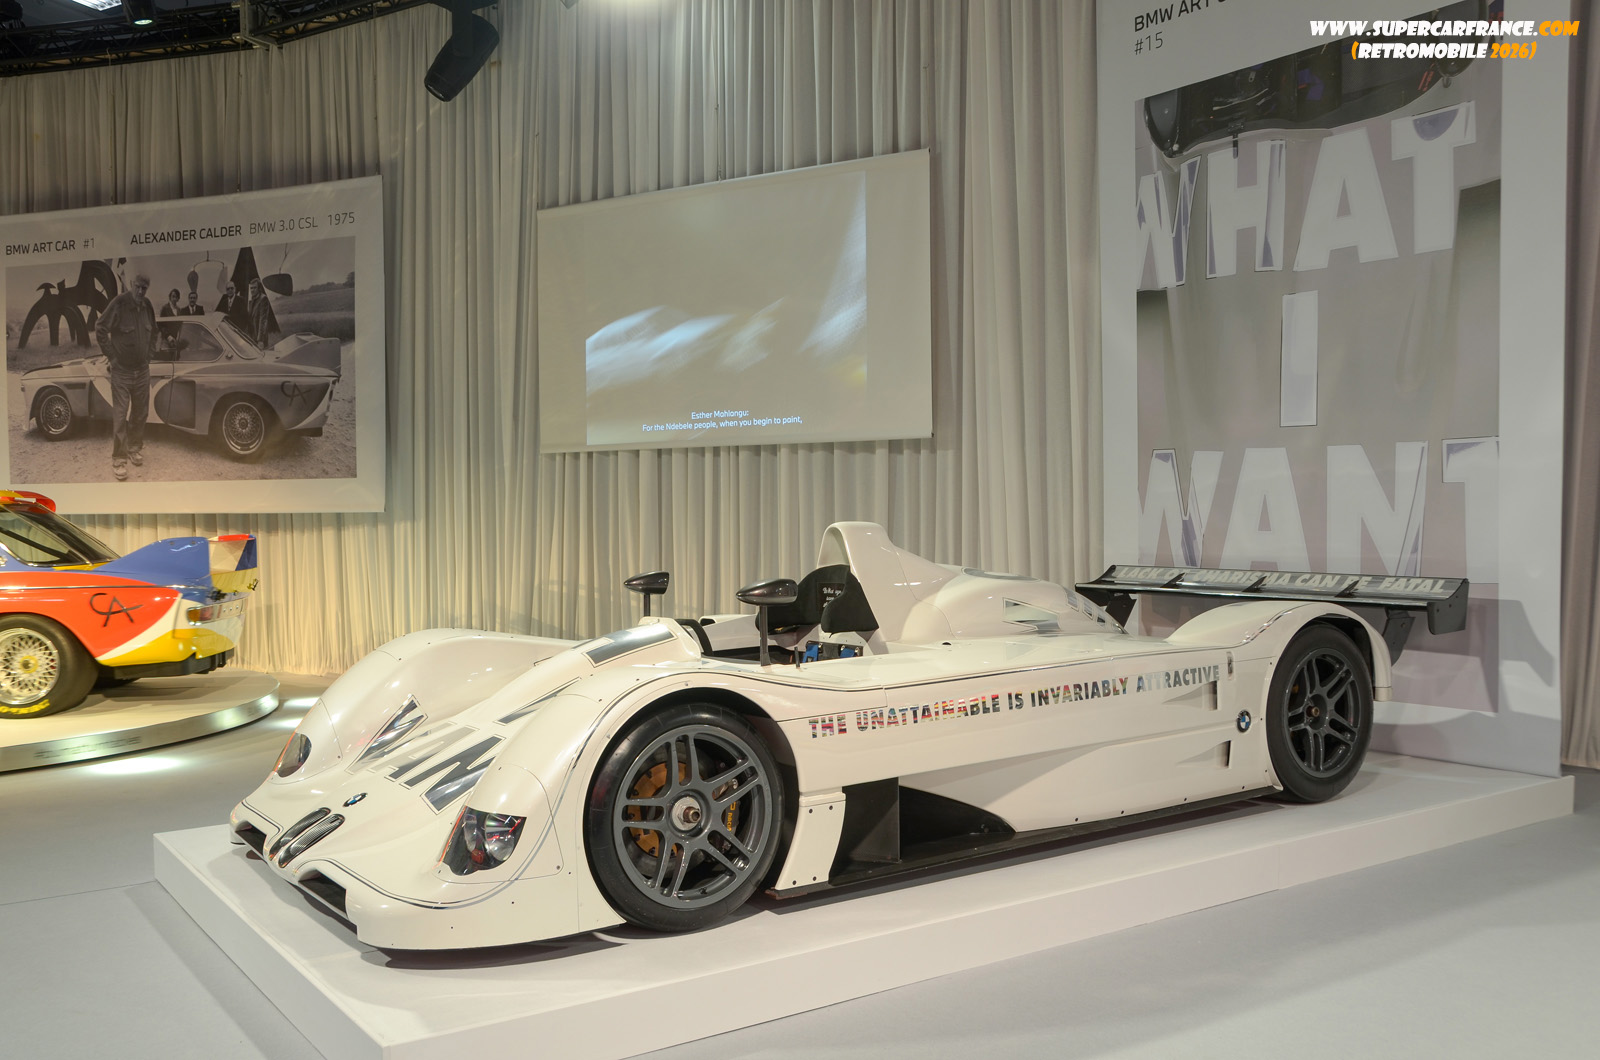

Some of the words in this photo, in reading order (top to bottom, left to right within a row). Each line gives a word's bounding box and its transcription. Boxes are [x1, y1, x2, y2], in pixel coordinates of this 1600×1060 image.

[1134, 4, 1174, 32] BMW
[1134, 31, 1164, 55] #15
[1135, 100, 1477, 290] WHAT
[6, 243, 30, 255] BMW
[32, 241, 53, 254] ART
[55, 240, 76, 252] CAR
[83, 238, 96, 249] #1
[130, 229, 197, 245] ALEXANDER
[199, 224, 242, 240] CALDER
[250, 220, 277, 235] BMW
[279, 218, 295, 232] 3.0
[298, 217, 319, 230] CSL
[327, 211, 355, 226] 1975
[1280, 290, 1318, 428] I
[642, 424, 653, 432] For
[654, 423, 665, 431] the
[666, 422, 693, 431] Ndebele
[693, 420, 719, 430] people,
[719, 419, 738, 428] when
[739, 418, 752, 428] you
[753, 416, 773, 427] begin
[773, 416, 781, 425] to
[782, 415, 803, 425] paint,
[691, 411, 712, 420] Esther
[713, 410, 749, 419] Mahlangu:
[1138, 436, 1499, 583] WANT
[1118, 566, 1160, 579] LACK
[1191, 570, 1291, 586] CHARISMA
[1294, 573, 1341, 588] CAN
[1377, 577, 1445, 593] FATAL
[808, 714, 847, 738] THE
[855, 693, 1000, 732] UNATTAINABLE
[1007, 691, 1024, 710] IS
[1031, 677, 1129, 707] INVARIABLY
[1136, 665, 1220, 693] ATTRACTIVE
